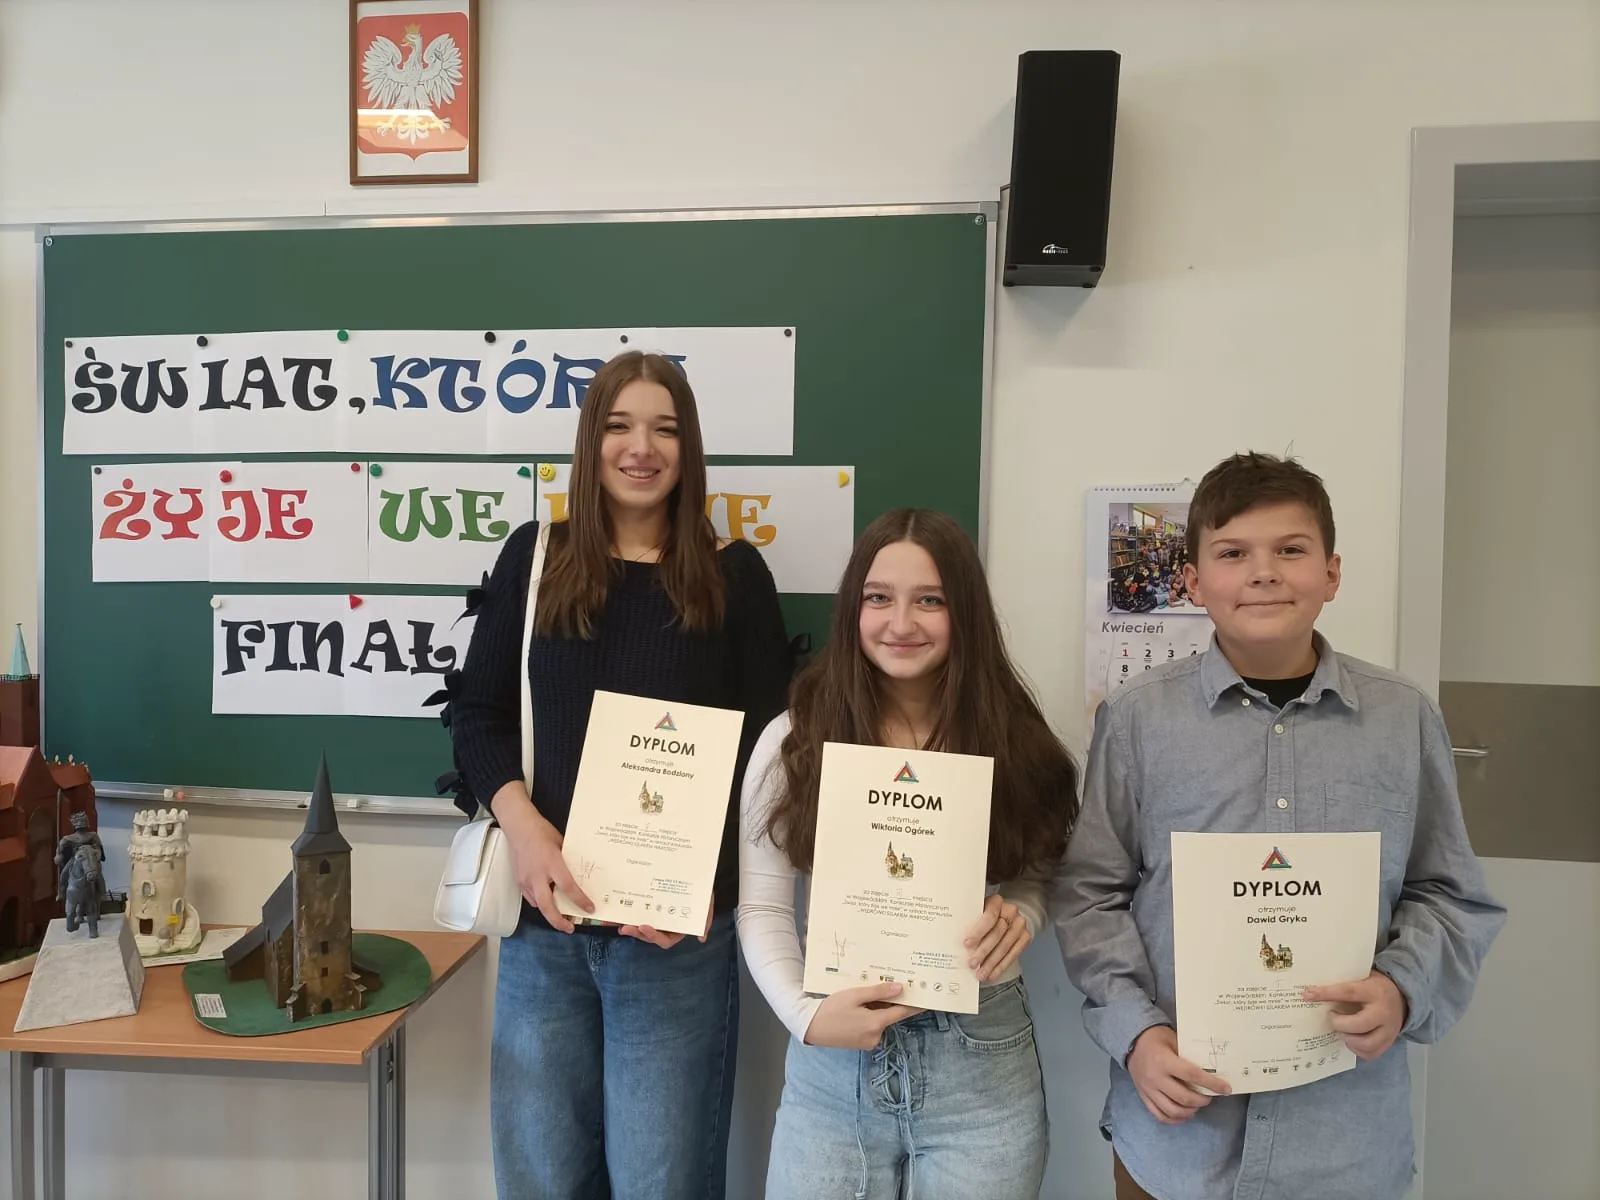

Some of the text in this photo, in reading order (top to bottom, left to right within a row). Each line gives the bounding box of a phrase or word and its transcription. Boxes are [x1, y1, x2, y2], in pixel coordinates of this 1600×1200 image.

[371, 338, 688, 413] KTÓR
[99, 478, 313, 543] ŻYJE
[379, 486, 510, 543] WE
[1102, 621, 1164, 634] Kwiecień
[221, 618, 457, 677] FINAŁ
[1122, 649, 1128, 657] 1
[1145, 649, 1151, 657] 2
[1168, 649, 1174, 657] 3
[1122, 664, 1128, 672] 8
[630, 734, 696, 757] DYPLOM
[621, 761, 661, 775] Aleksandra
[868, 789, 943, 812] DYPLOM
[886, 815, 920, 826] otrzymuje
[871, 822, 936, 837] Wiktoria Ogórek
[1232, 880, 1322, 898] DYPLOM
[1257, 906, 1297, 915] otrzymuje
[1247, 914, 1308, 925] Dawid Gryka
